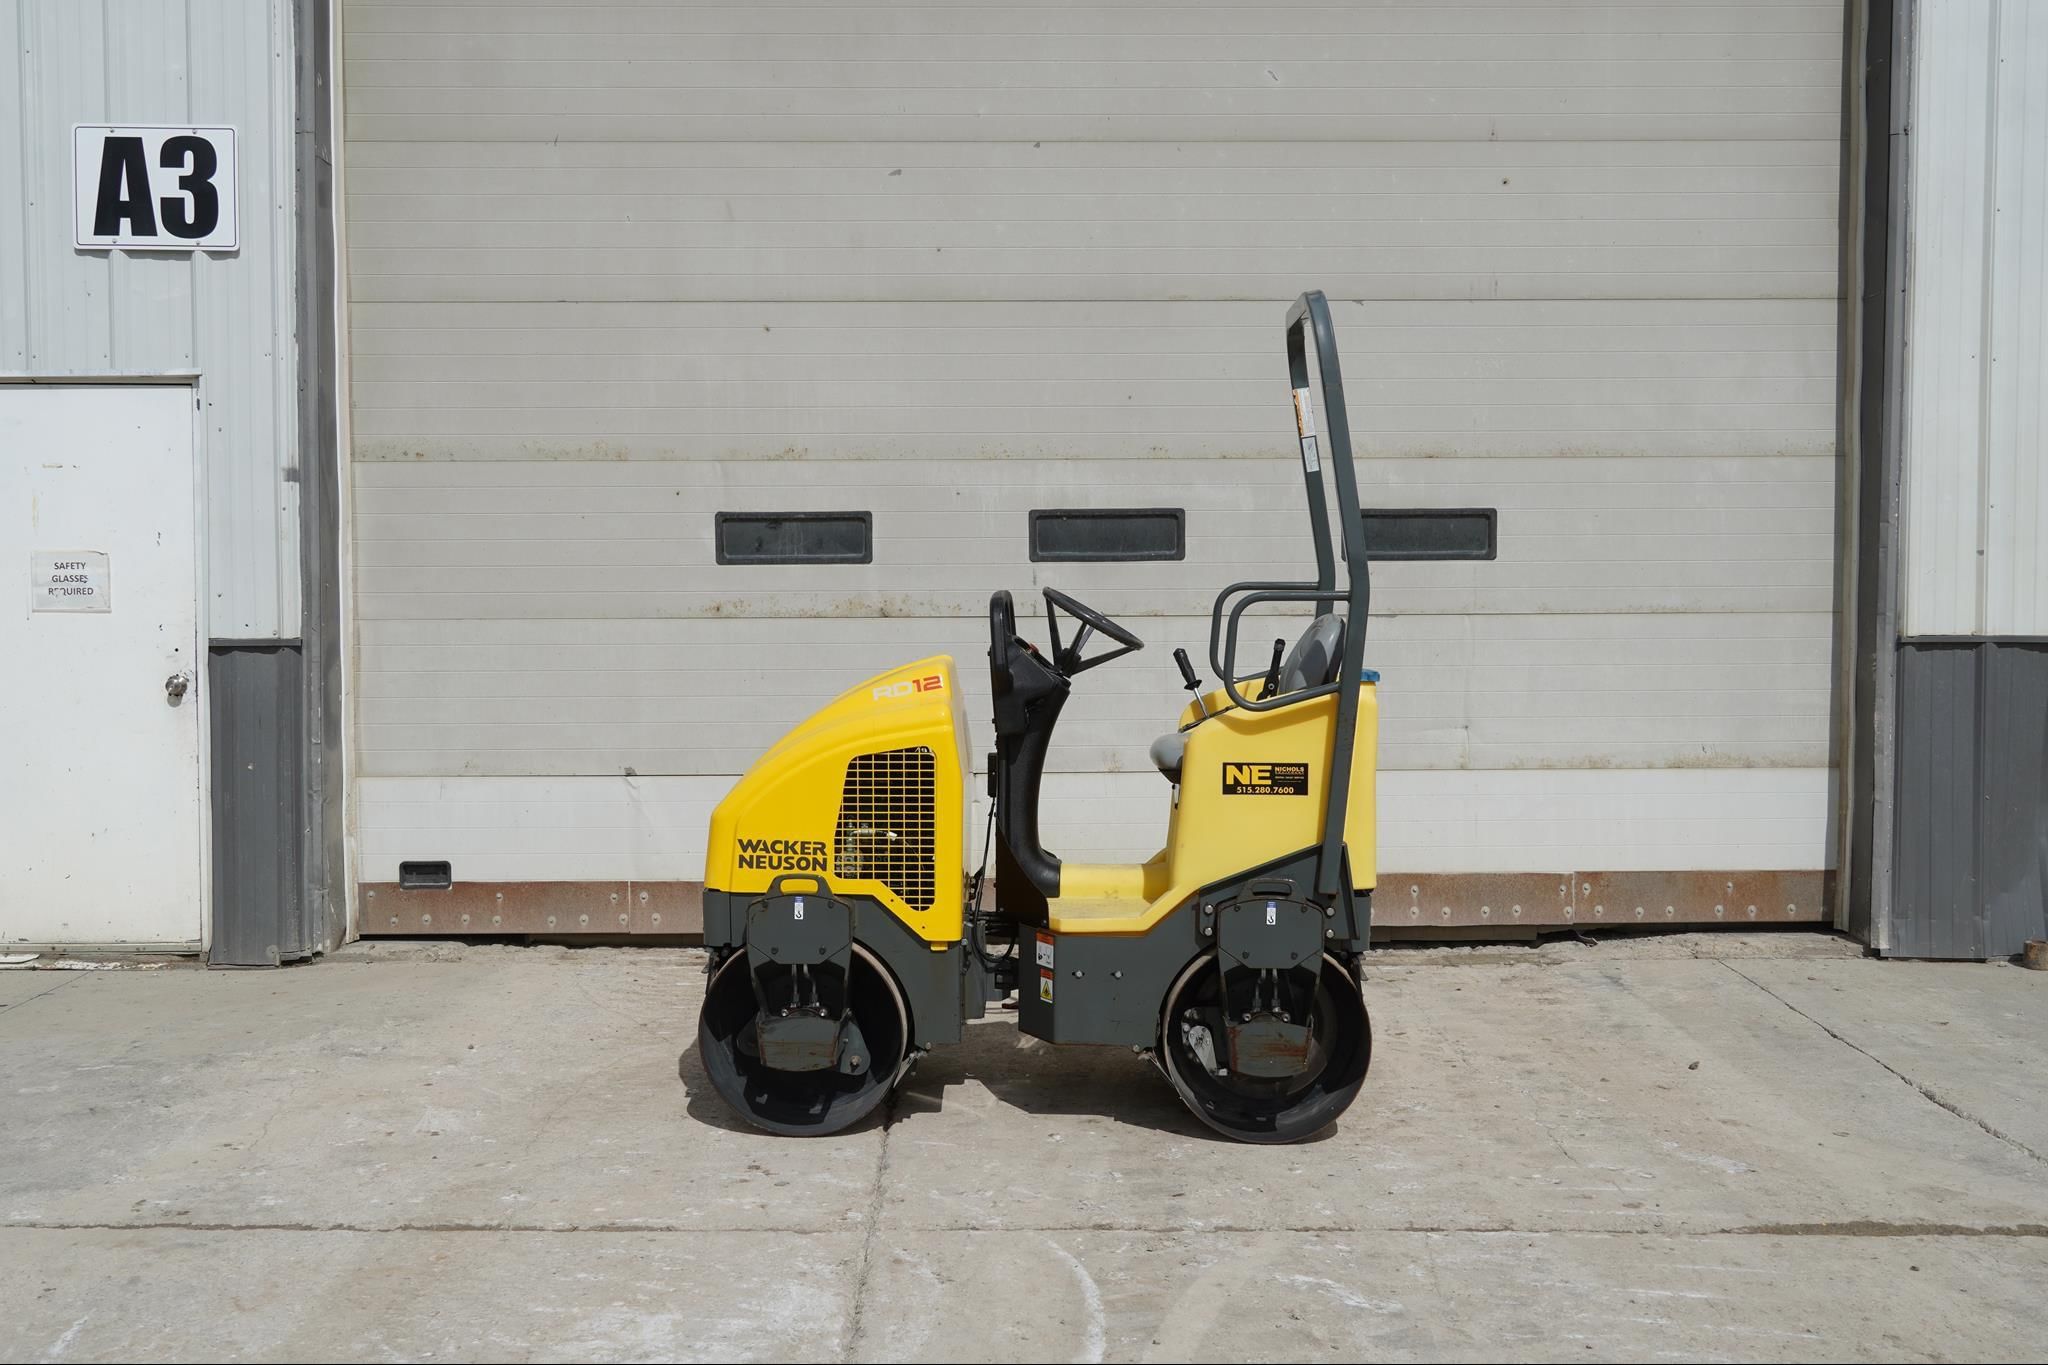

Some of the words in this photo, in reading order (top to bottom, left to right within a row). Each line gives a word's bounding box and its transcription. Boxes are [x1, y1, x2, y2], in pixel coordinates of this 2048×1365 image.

[93, 135, 219, 239] A3
[54, 562, 86, 570] SAFETY
[51, 574, 88, 583] GLASSES
[1226, 765, 1272, 785] NE
[1236, 786, 1294, 794] 515.280.7600
[737, 838, 828, 856] WACKER
[738, 854, 828, 872] NEUSON
